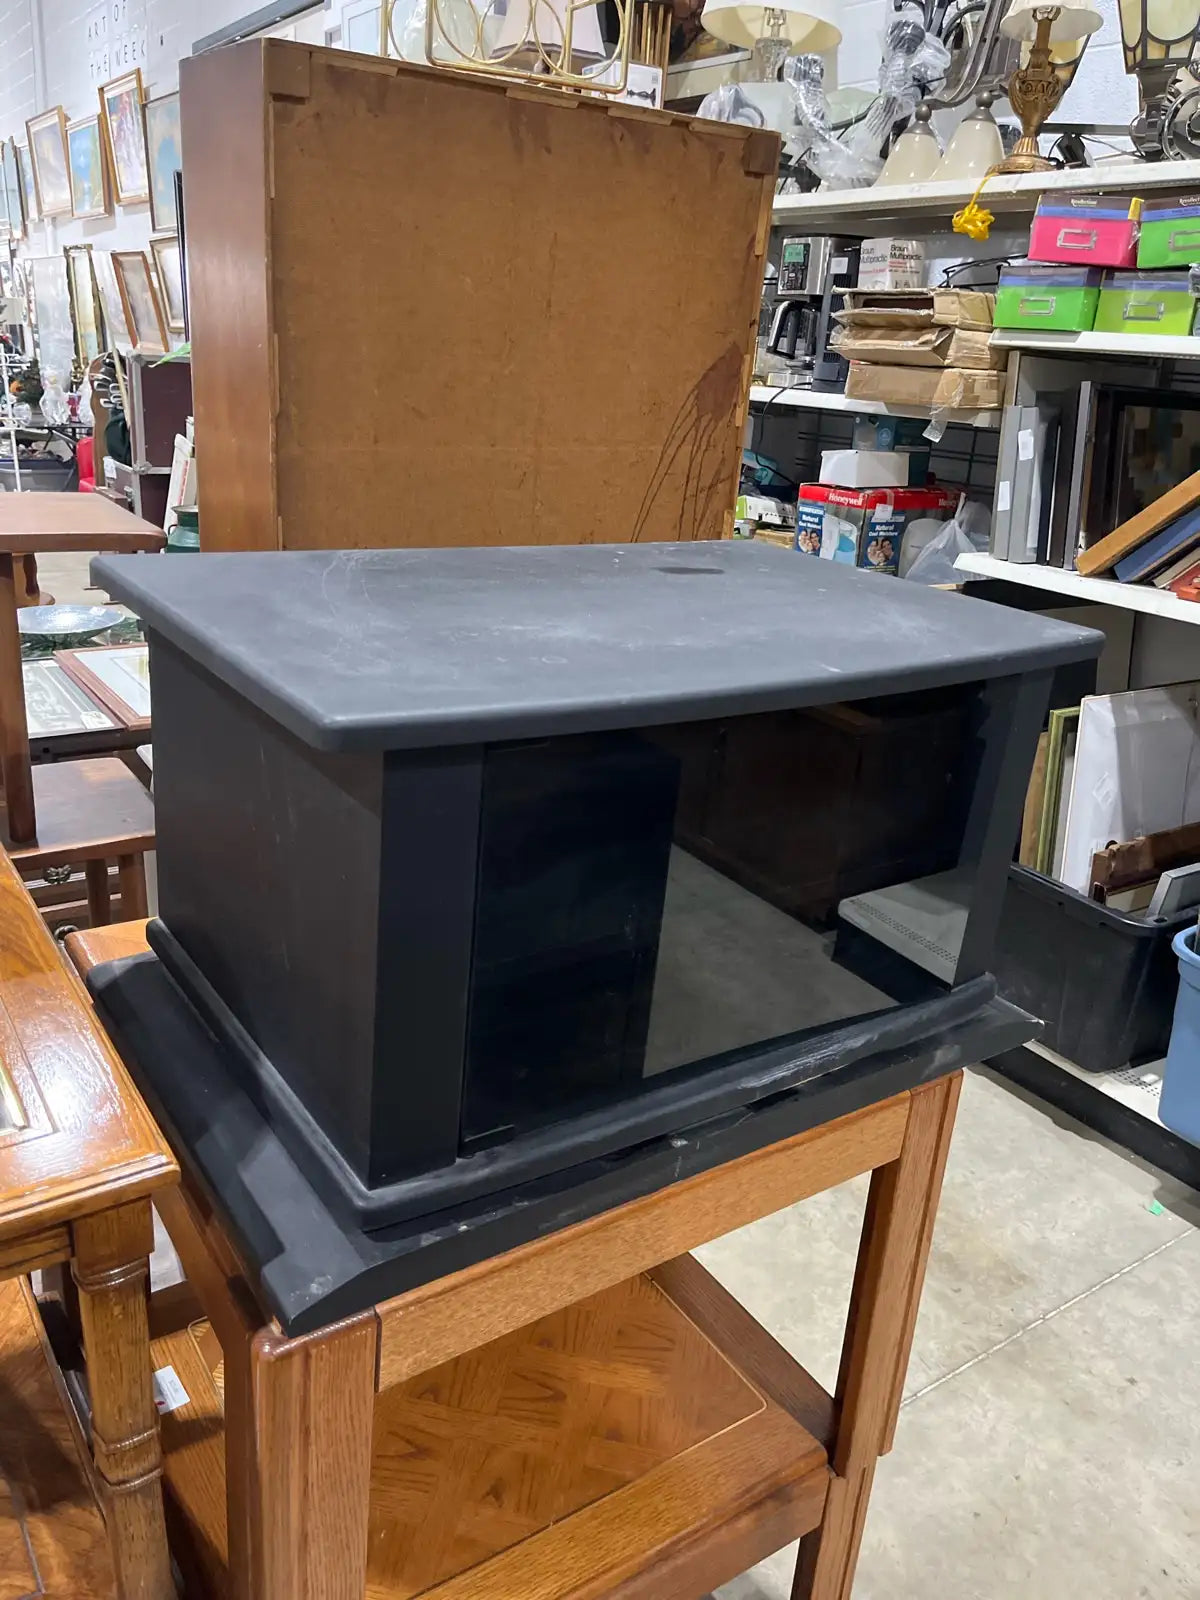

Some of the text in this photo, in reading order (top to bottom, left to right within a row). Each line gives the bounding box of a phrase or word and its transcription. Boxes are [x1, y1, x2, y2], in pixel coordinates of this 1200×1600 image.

[88, 15, 106, 40] ART
[89, 39, 146, 79] THE WEEK
[890, 244, 908, 252] Braun
[828, 492, 864, 506] Honeywell
